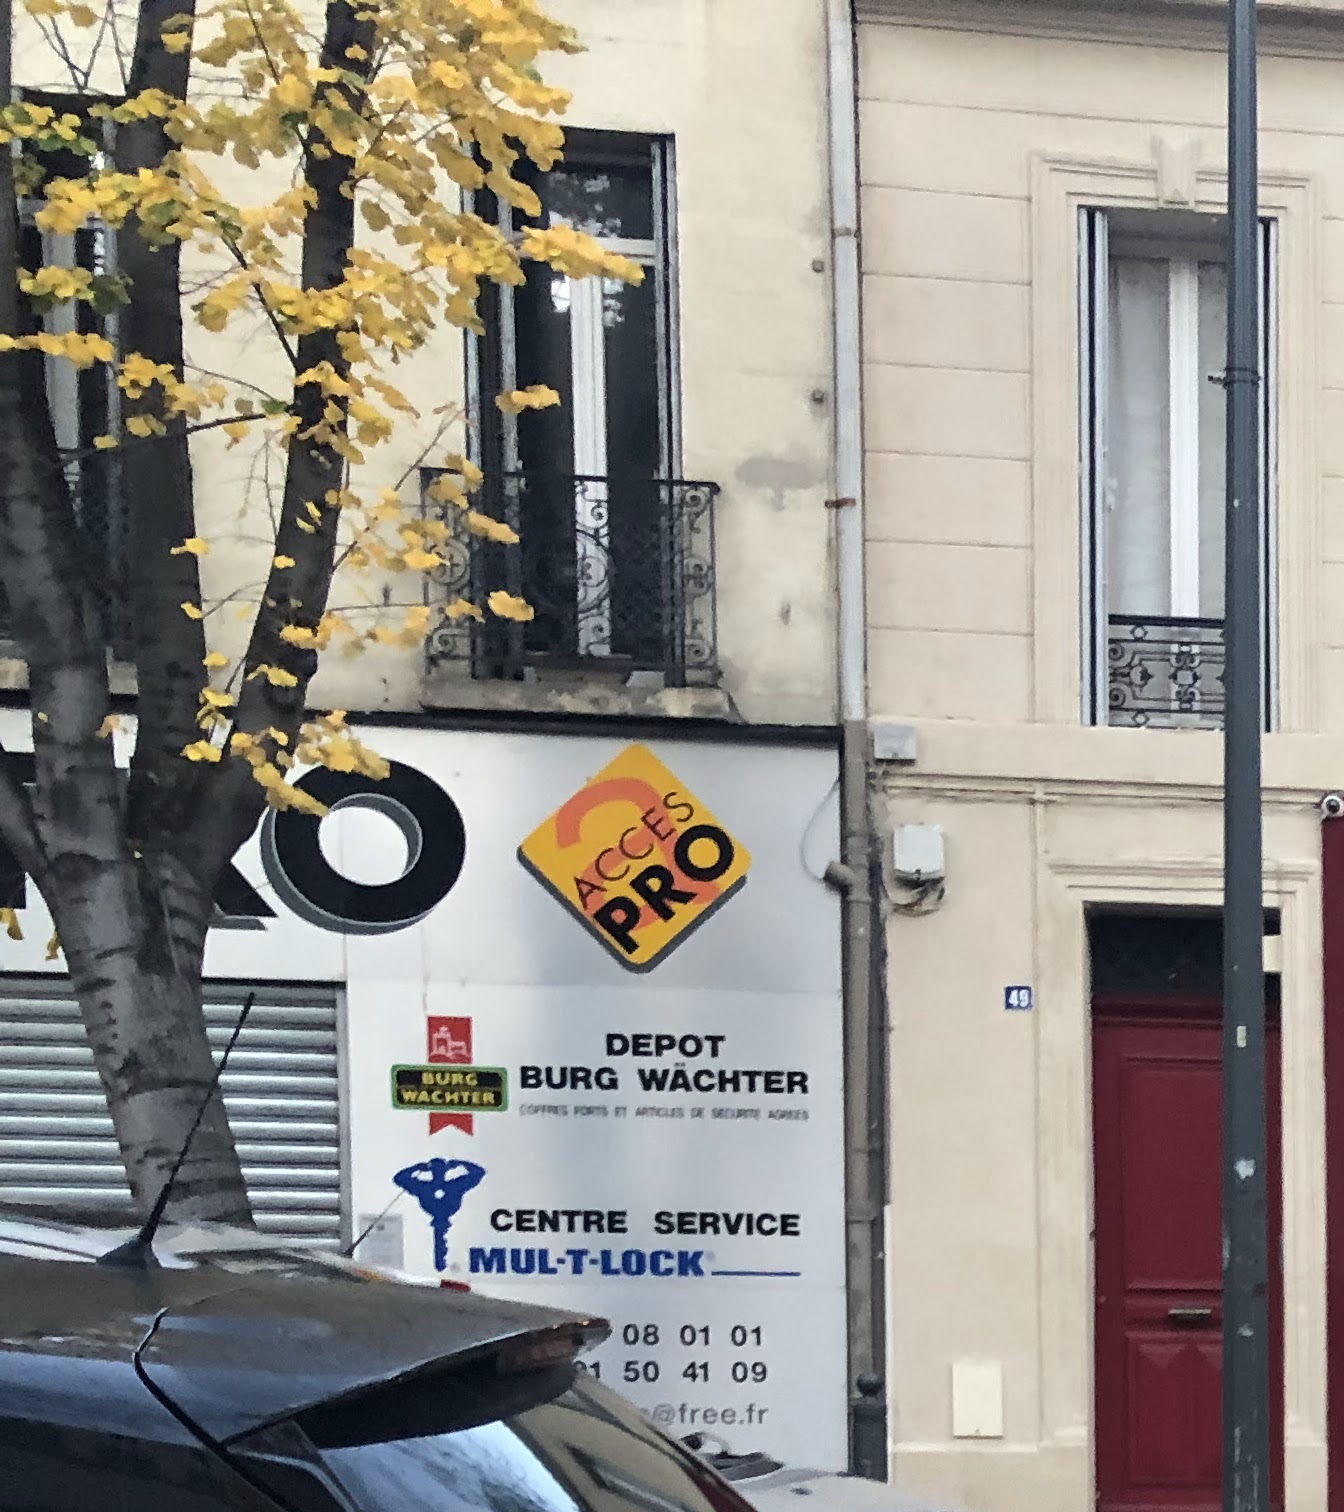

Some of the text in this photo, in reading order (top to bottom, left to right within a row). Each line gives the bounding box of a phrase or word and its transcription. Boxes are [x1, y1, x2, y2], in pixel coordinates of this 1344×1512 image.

[574, 791, 694, 910] ACCES
[593, 824, 734, 954] PRO
[606, 1033, 726, 1057] DEPOT
[422, 1072, 477, 1086] BURG
[520, 1062, 810, 1094] BURG WÄCHTER
[490, 1209, 801, 1237] CENTRE SERVICE
[468, 1247, 705, 1277] MUL-T-LOCK
[623, 1323, 762, 1347] 08 01 01
[624, 1360, 660, 1383] 50
[681, 1361, 710, 1383] 41
[732, 1361, 767, 1383] 09
